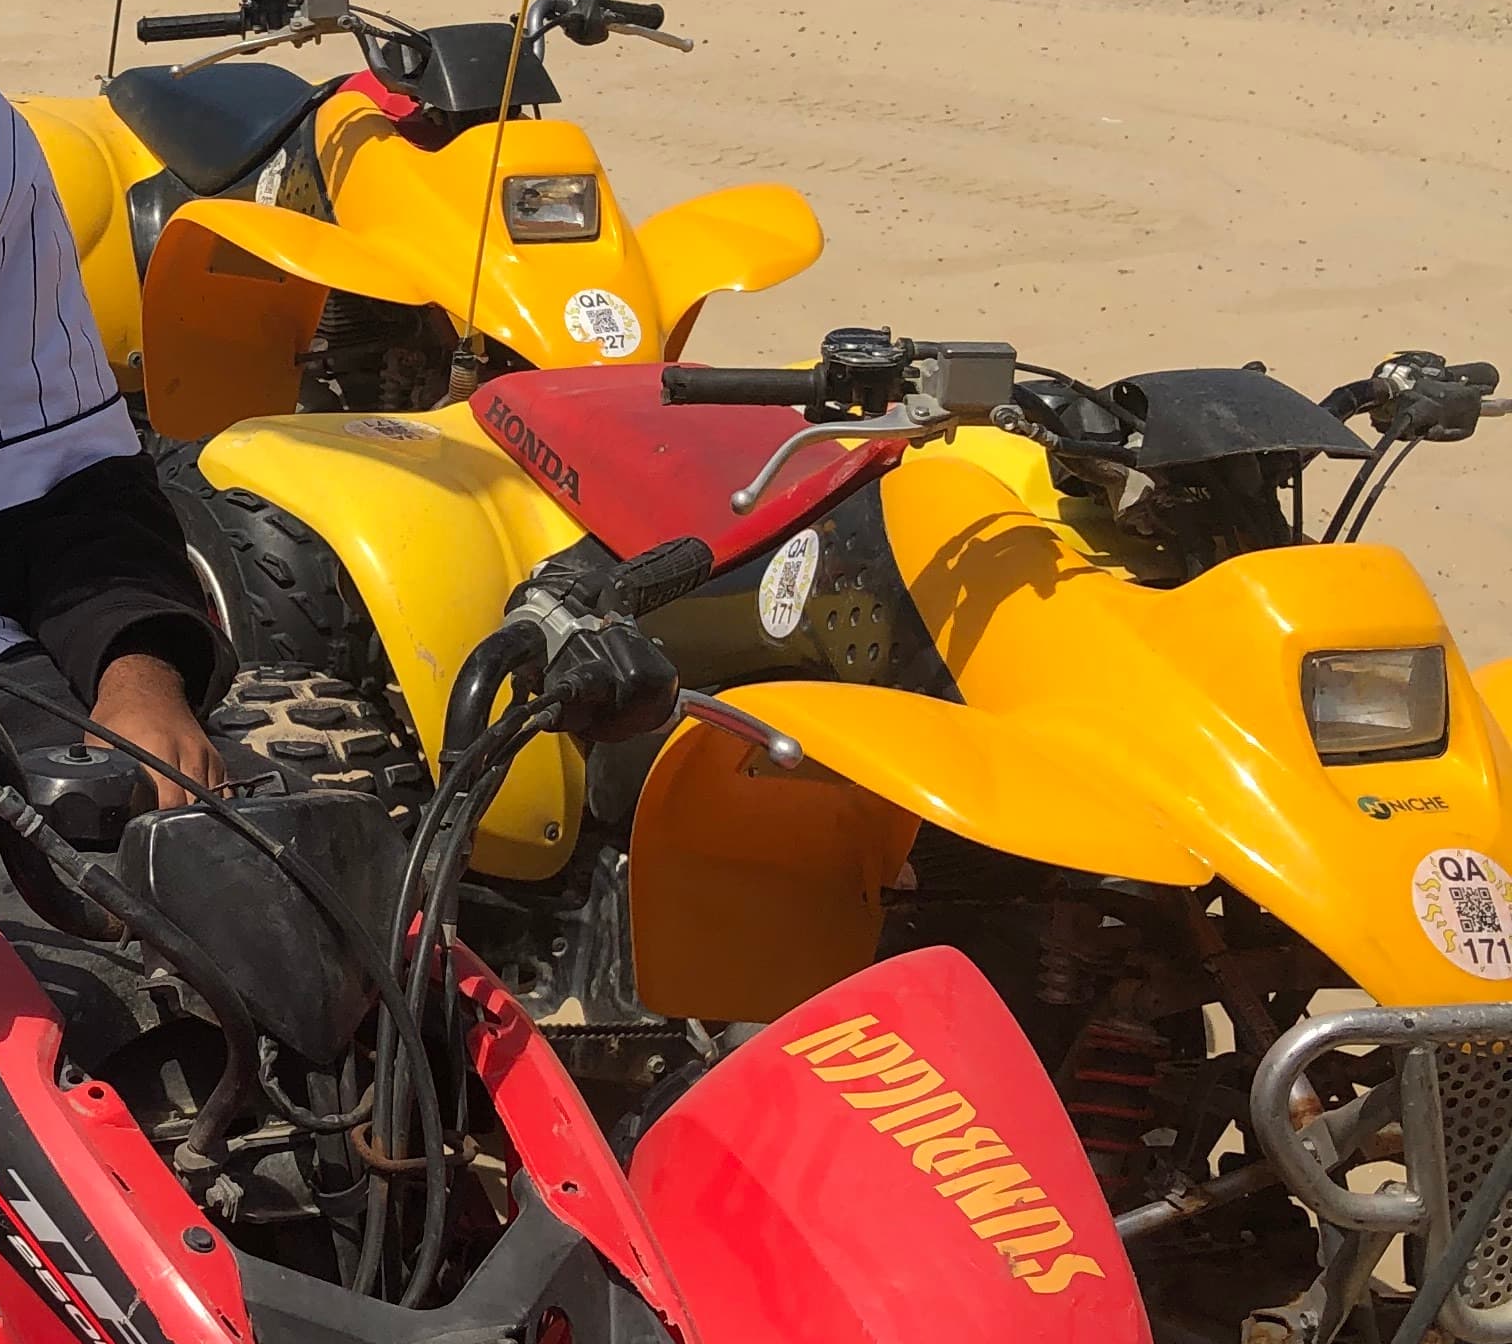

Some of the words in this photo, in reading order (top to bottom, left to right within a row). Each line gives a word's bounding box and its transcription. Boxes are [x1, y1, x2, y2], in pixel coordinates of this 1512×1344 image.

[579, 293, 610, 308] QA
[484, 395, 581, 505] HONDA
[788, 537, 809, 558] QA
[771, 601, 794, 625] 171
[1389, 796, 1449, 813] NICHE
[1438, 856, 1488, 883] QA
[1463, 937, 1512, 965] 171
[781, 1014, 1107, 1294] SUNBUGGY
